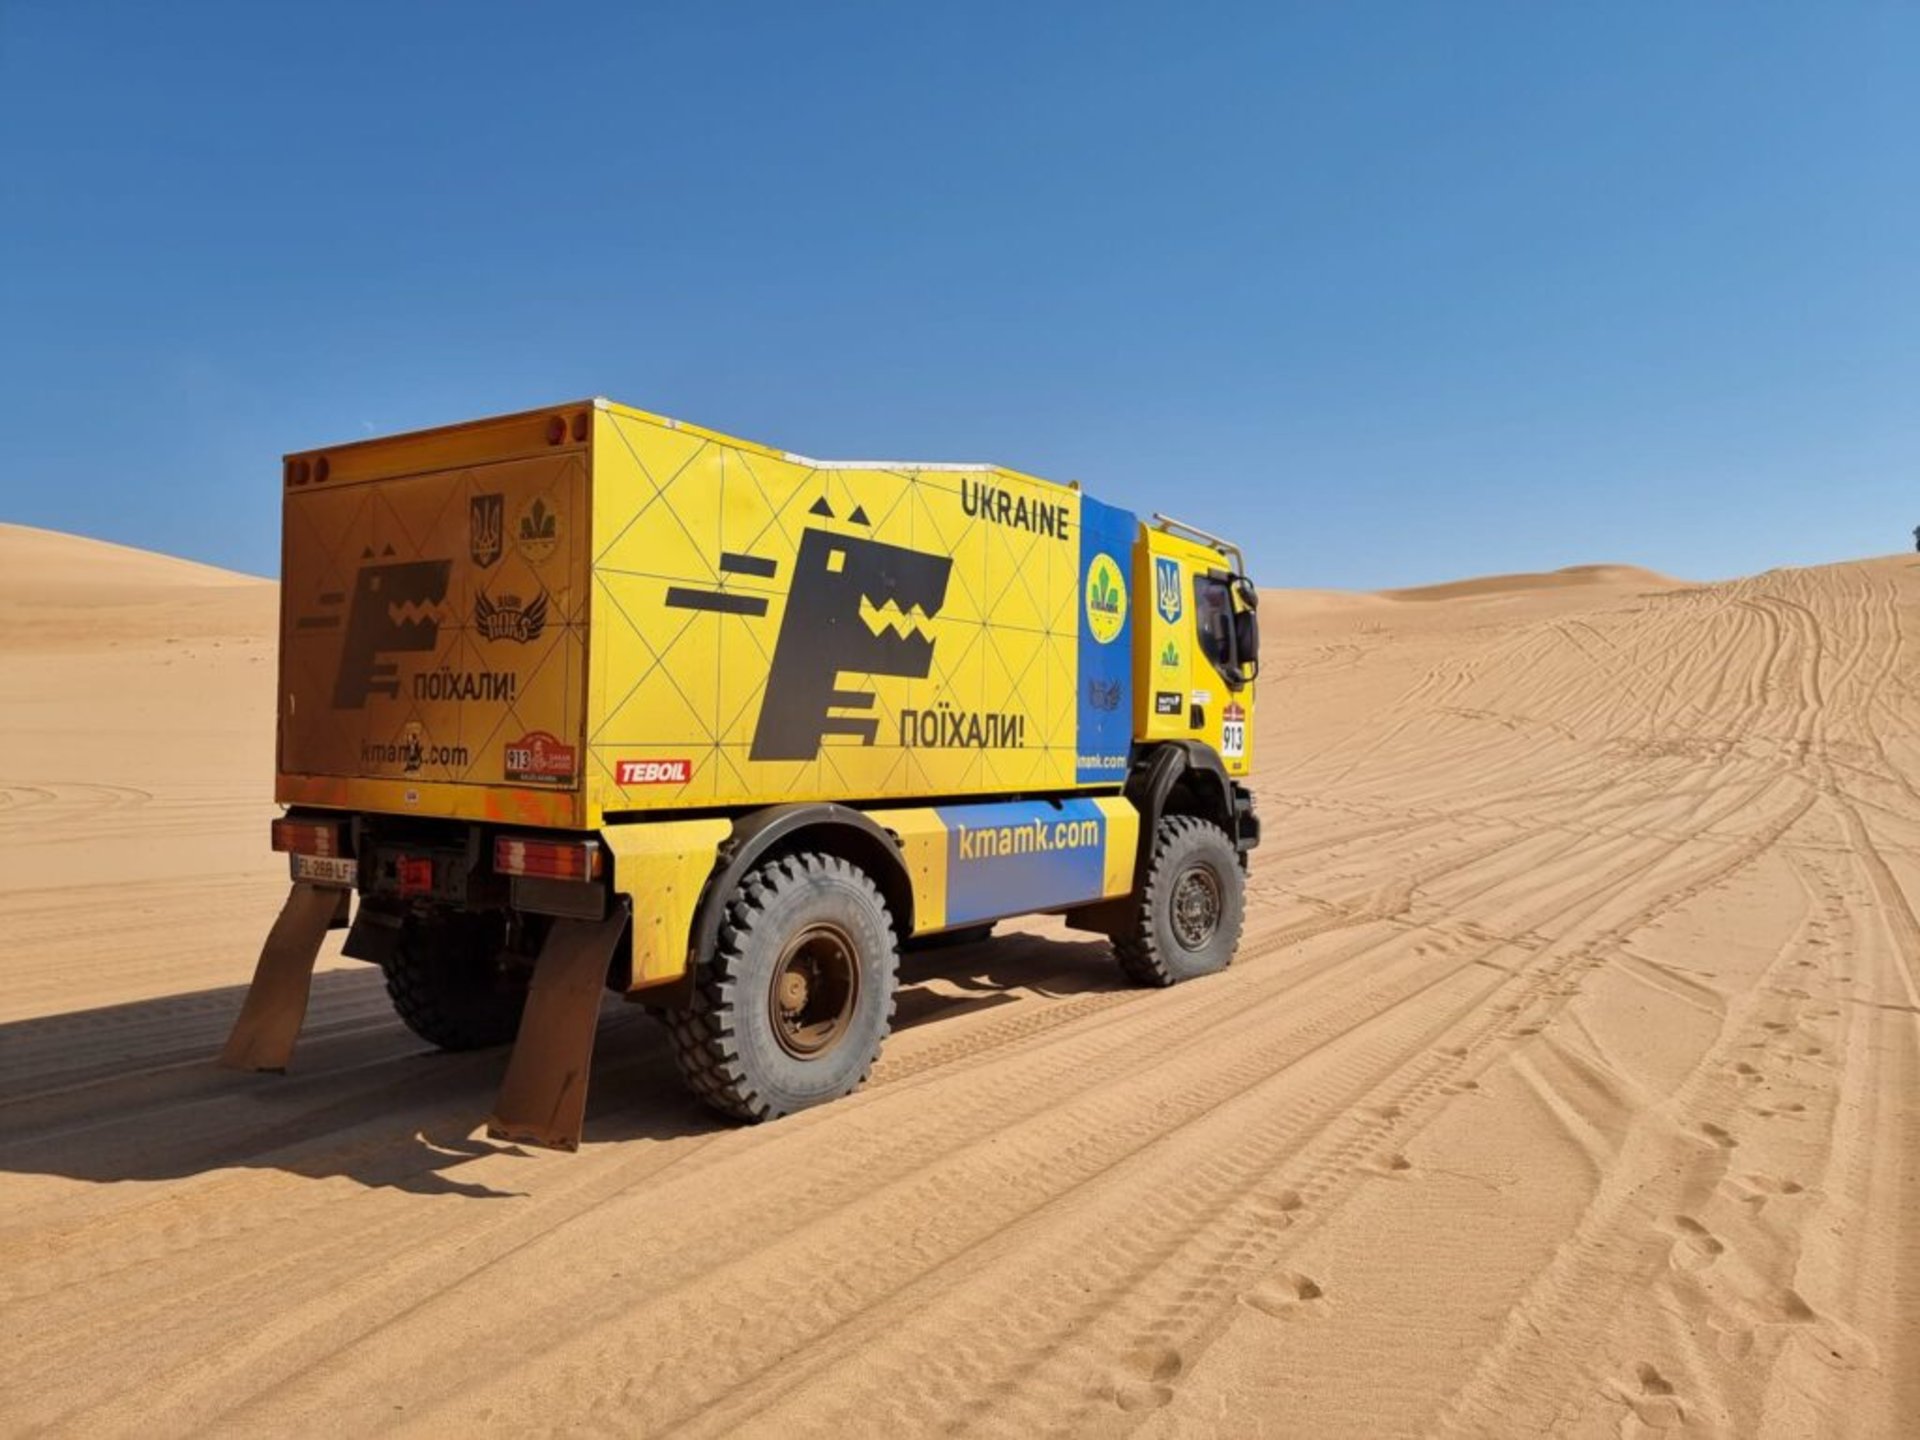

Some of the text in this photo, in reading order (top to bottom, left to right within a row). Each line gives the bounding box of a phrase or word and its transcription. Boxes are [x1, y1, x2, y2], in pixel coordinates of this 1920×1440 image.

[961, 478, 1069, 541] UKRAINE
[413, 666, 516, 701] ПОЇХАЛИ!
[900, 701, 1024, 748] ПОЇХАЛИ!
[1223, 726, 1242, 750] 913
[507, 750, 530, 768] 913
[622, 762, 686, 783] TEBOIL
[959, 817, 1098, 860] kmamk.com
